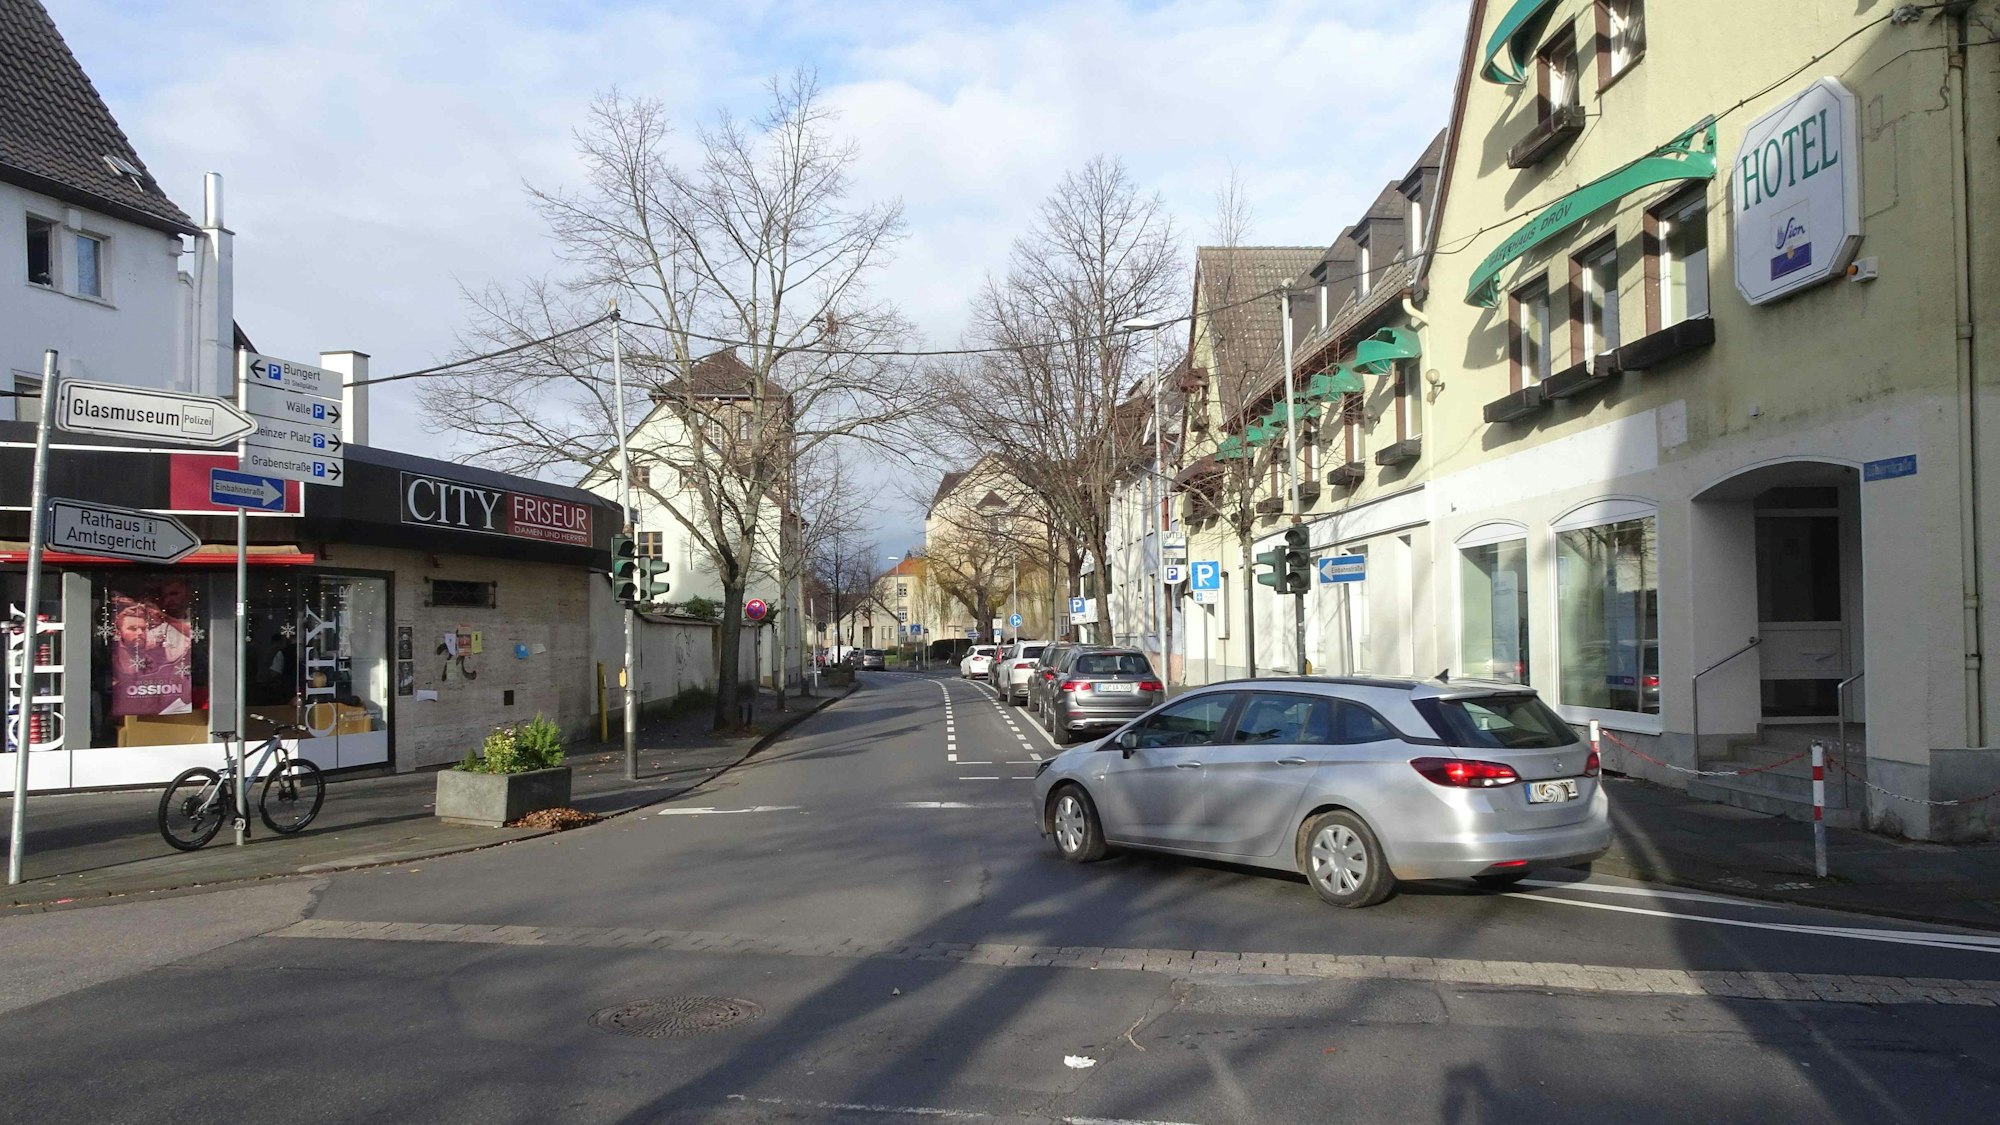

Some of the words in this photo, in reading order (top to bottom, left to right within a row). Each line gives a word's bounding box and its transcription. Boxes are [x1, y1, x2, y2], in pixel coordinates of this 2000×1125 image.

[1742, 109, 1838, 211] HOTEL
[1775, 217, 1806, 250] Sion
[283, 363, 321, 381] Bungert
[73, 398, 180, 427] Glasmuseum
[184, 415, 212, 426] Polizei
[290, 430, 312, 444] Platz
[252, 454, 312, 473] Grabenstraße
[215, 482, 265, 497] Einbahnstraße
[407, 478, 502, 530] CITY
[514, 496, 587, 530] FRISEUR
[80, 510, 140, 533] Rathaus
[66, 526, 157, 552] Amtsgericht
[514, 525, 543, 537] DAMEN
[544, 530, 560, 539] UND
[561, 533, 587, 543] HERREN
[305, 603, 337, 738] CITY
[126, 684, 183, 696] OSSION
